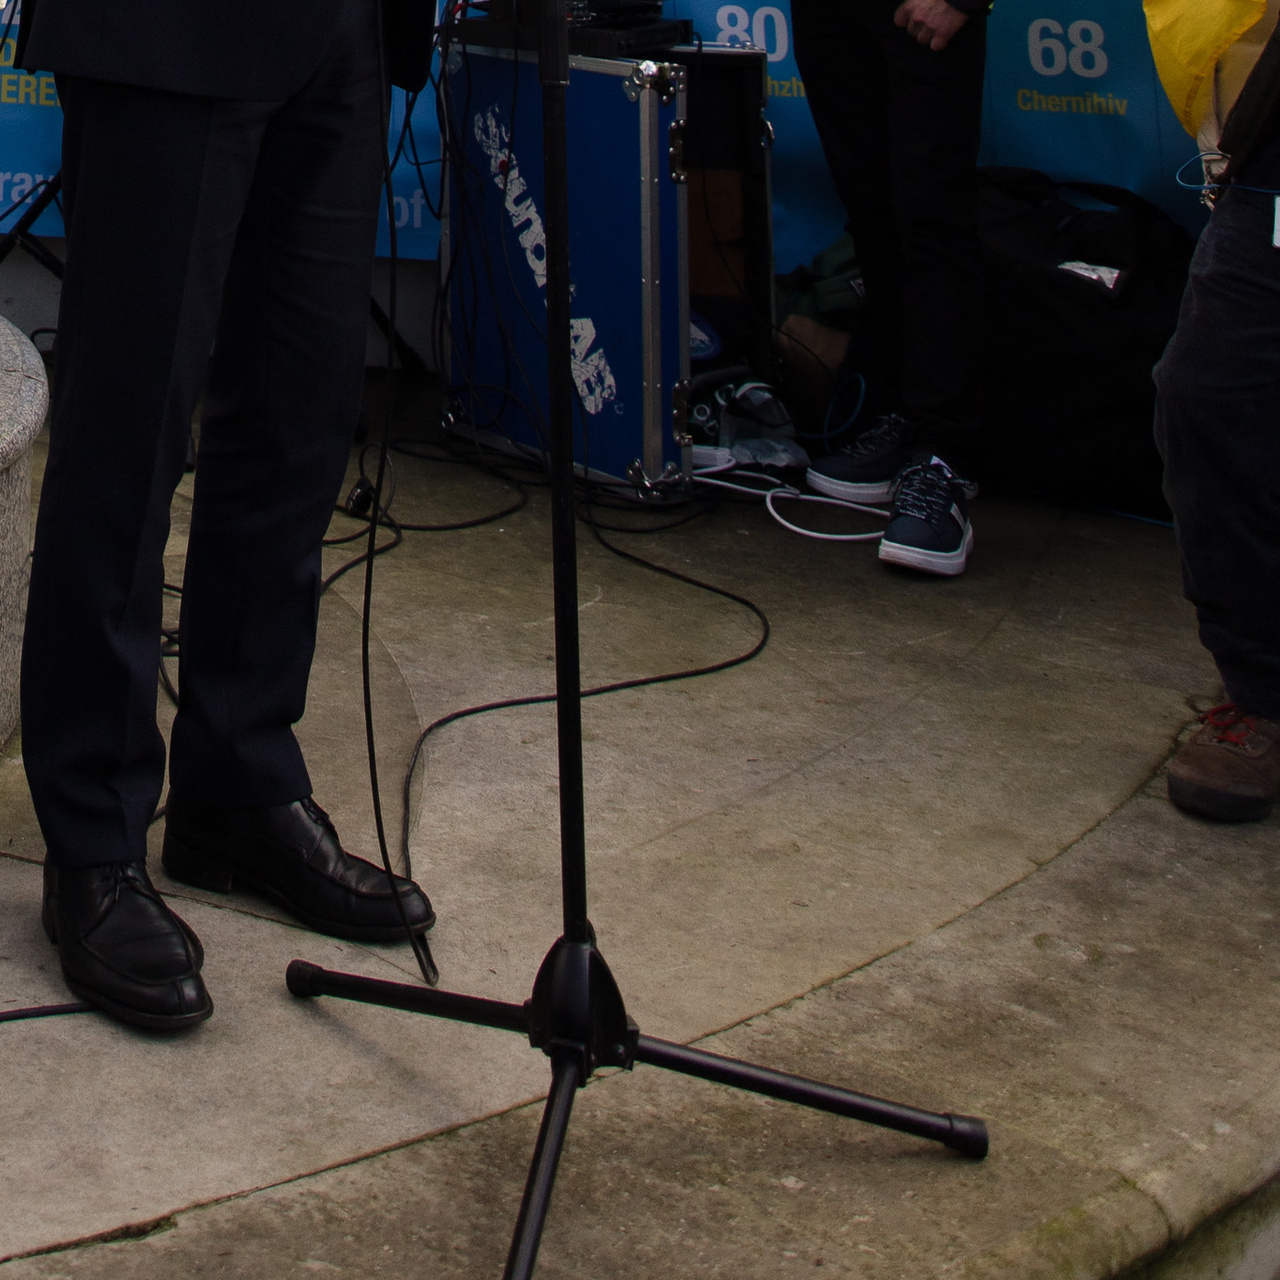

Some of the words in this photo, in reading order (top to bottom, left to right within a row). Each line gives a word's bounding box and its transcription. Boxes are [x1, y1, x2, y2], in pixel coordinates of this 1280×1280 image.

[716, 4, 789, 62] 80
[1028, 18, 1109, 79] 68
[1017, 88, 1129, 117] Chernihiv
